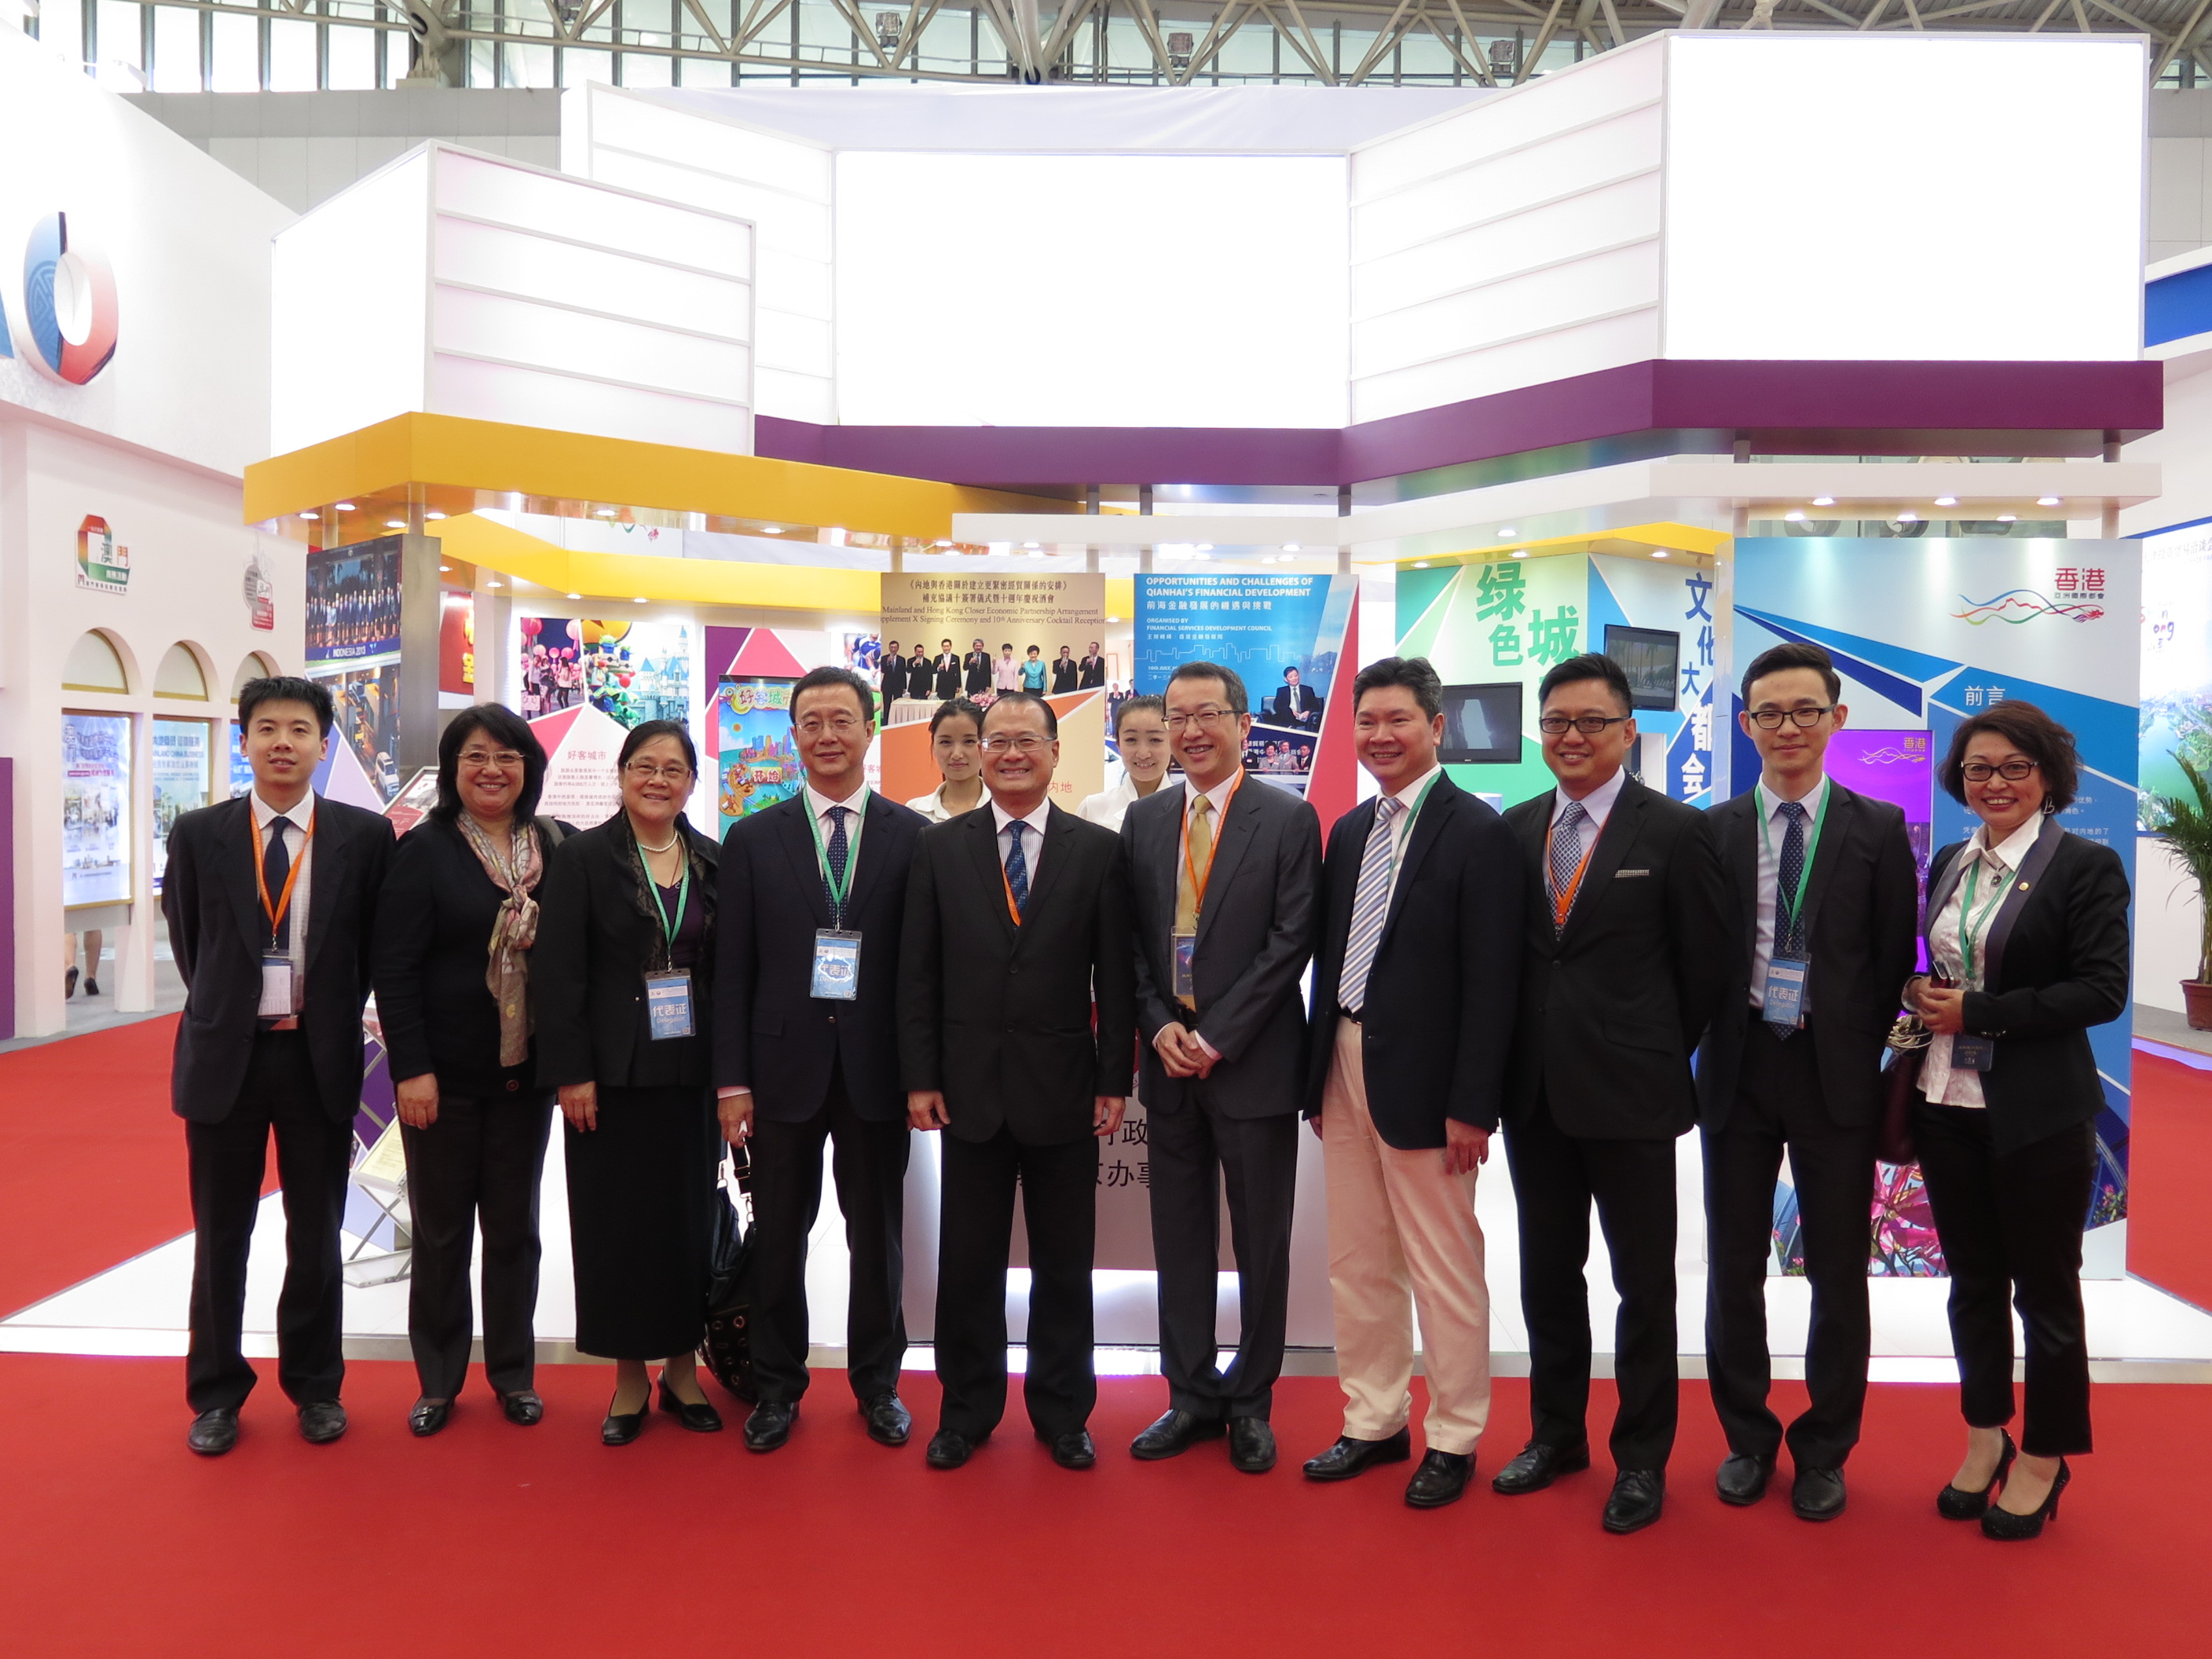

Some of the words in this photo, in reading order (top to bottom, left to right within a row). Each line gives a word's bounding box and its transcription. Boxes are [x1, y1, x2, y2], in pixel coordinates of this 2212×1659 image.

[1146, 577, 1218, 586] OPPORTUNITIES
[1219, 577, 1240, 586] AND
[1242, 577, 1299, 586] CHALLENGES
[1301, 577, 1313, 586] OF
[2055, 568, 2104, 591] 香港
[927, 606, 944, 615] Hong
[1020, 607, 1055, 616] Partnership
[1147, 600, 1272, 610] 前海金融發展的機遇與挑戰
[920, 616, 944, 624] Signing
[945, 617, 978, 625] Ceremony
[333, 648, 355, 657] INDONESIA
[356, 646, 366, 655] 2013
[1965, 685, 2005, 706] 前言
[1903, 736, 1927, 749] 香港
[567, 750, 607, 760] 好客城市
[754, 770, 779, 782] 开始
[1048, 781, 1072, 793] 内地
[1768, 986, 1799, 1002] 代表证
[653, 1003, 687, 1017] 代表证
